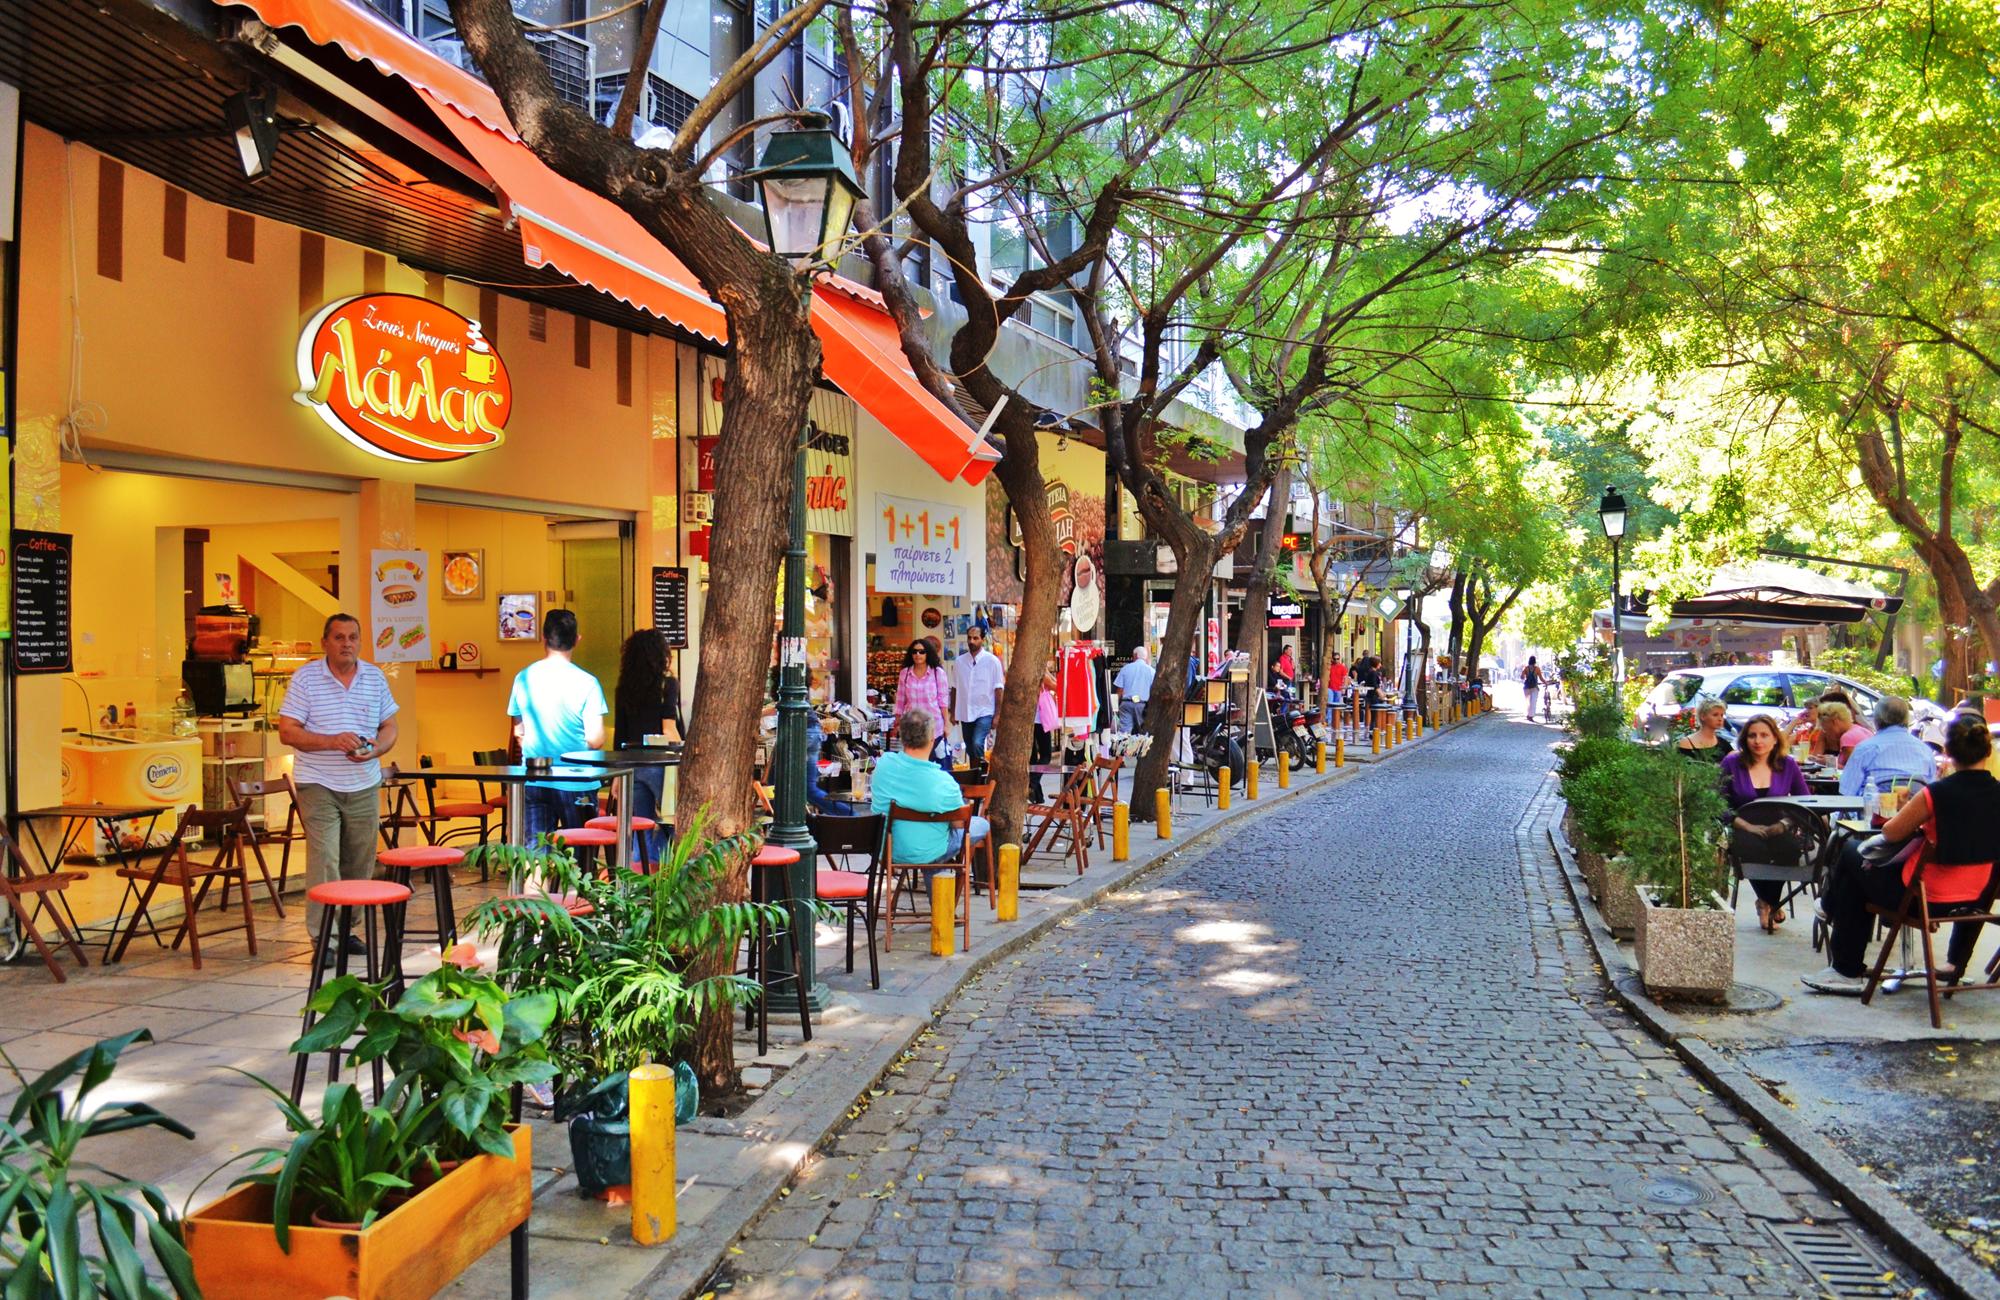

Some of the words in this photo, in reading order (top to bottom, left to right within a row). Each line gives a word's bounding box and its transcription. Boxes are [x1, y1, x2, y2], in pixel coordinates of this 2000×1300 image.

[29, 538, 57, 552] Coffee
[894, 545, 941, 569] παίρνετε
[944, 547, 953, 565] 2
[890, 560, 946, 590] πληρώνετε
[948, 568, 955, 585] 1
